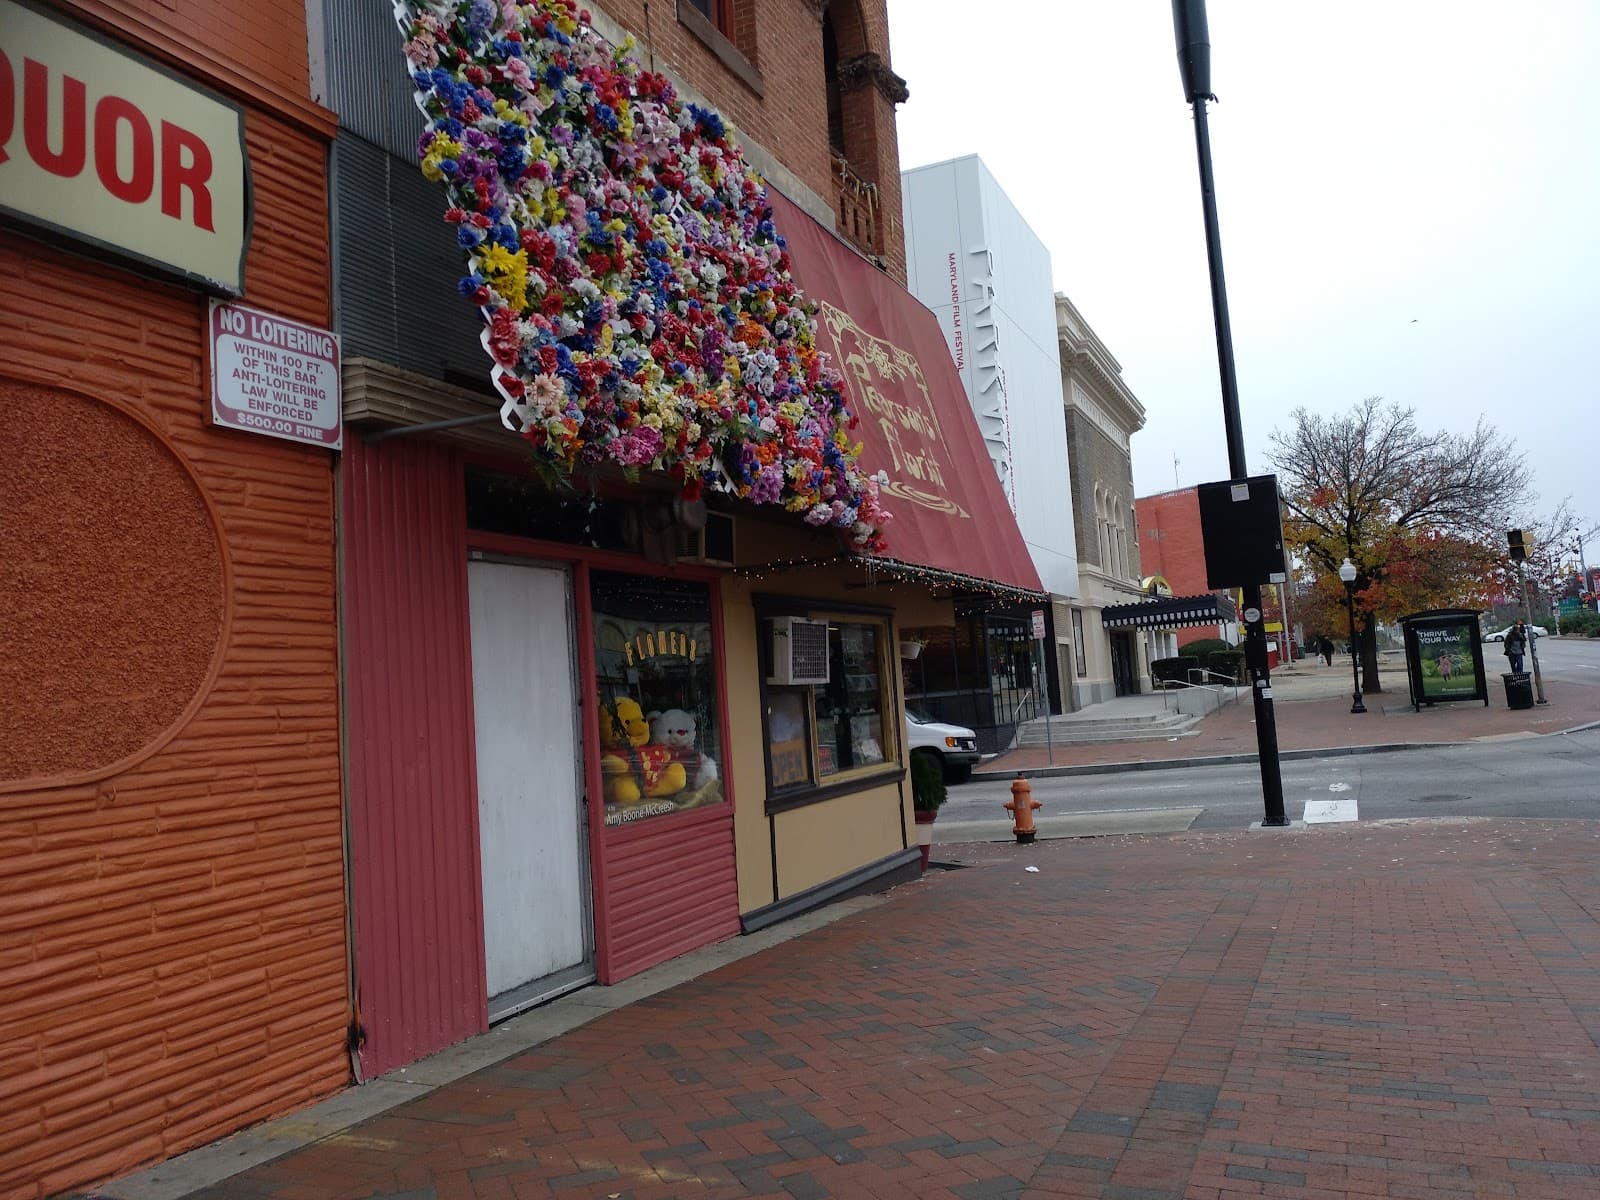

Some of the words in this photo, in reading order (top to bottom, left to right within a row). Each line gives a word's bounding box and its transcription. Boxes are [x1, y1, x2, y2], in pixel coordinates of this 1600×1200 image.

[0, 47, 216, 234] UOR
[948, 252, 959, 302] MARYLAND
[953, 305, 961, 327] FILM
[220, 308, 246, 335] NO
[251, 316, 333, 359] LOITERING
[233, 342, 277, 362] WITHIN
[281, 354, 302, 369] 100
[306, 361, 323, 375] FT.
[954, 330, 964, 372] FESTIVAL
[232, 368, 326, 400] ANTI-LOITERING
[242, 357, 259, 369] OF
[264, 363, 290, 378] THIS
[294, 371, 317, 385] BAR
[241, 383, 267, 398] LAW
[272, 391, 299, 406] WILL
[303, 398, 318, 410] BE
[248, 399, 313, 421] ENFORCED
[237, 412, 292, 433] $500.00
[296, 424, 323, 439] FINE
[878, 417, 948, 492] Florist
[624, 630, 697, 667] FLOWERS
[606, 814, 622, 826] Amy
